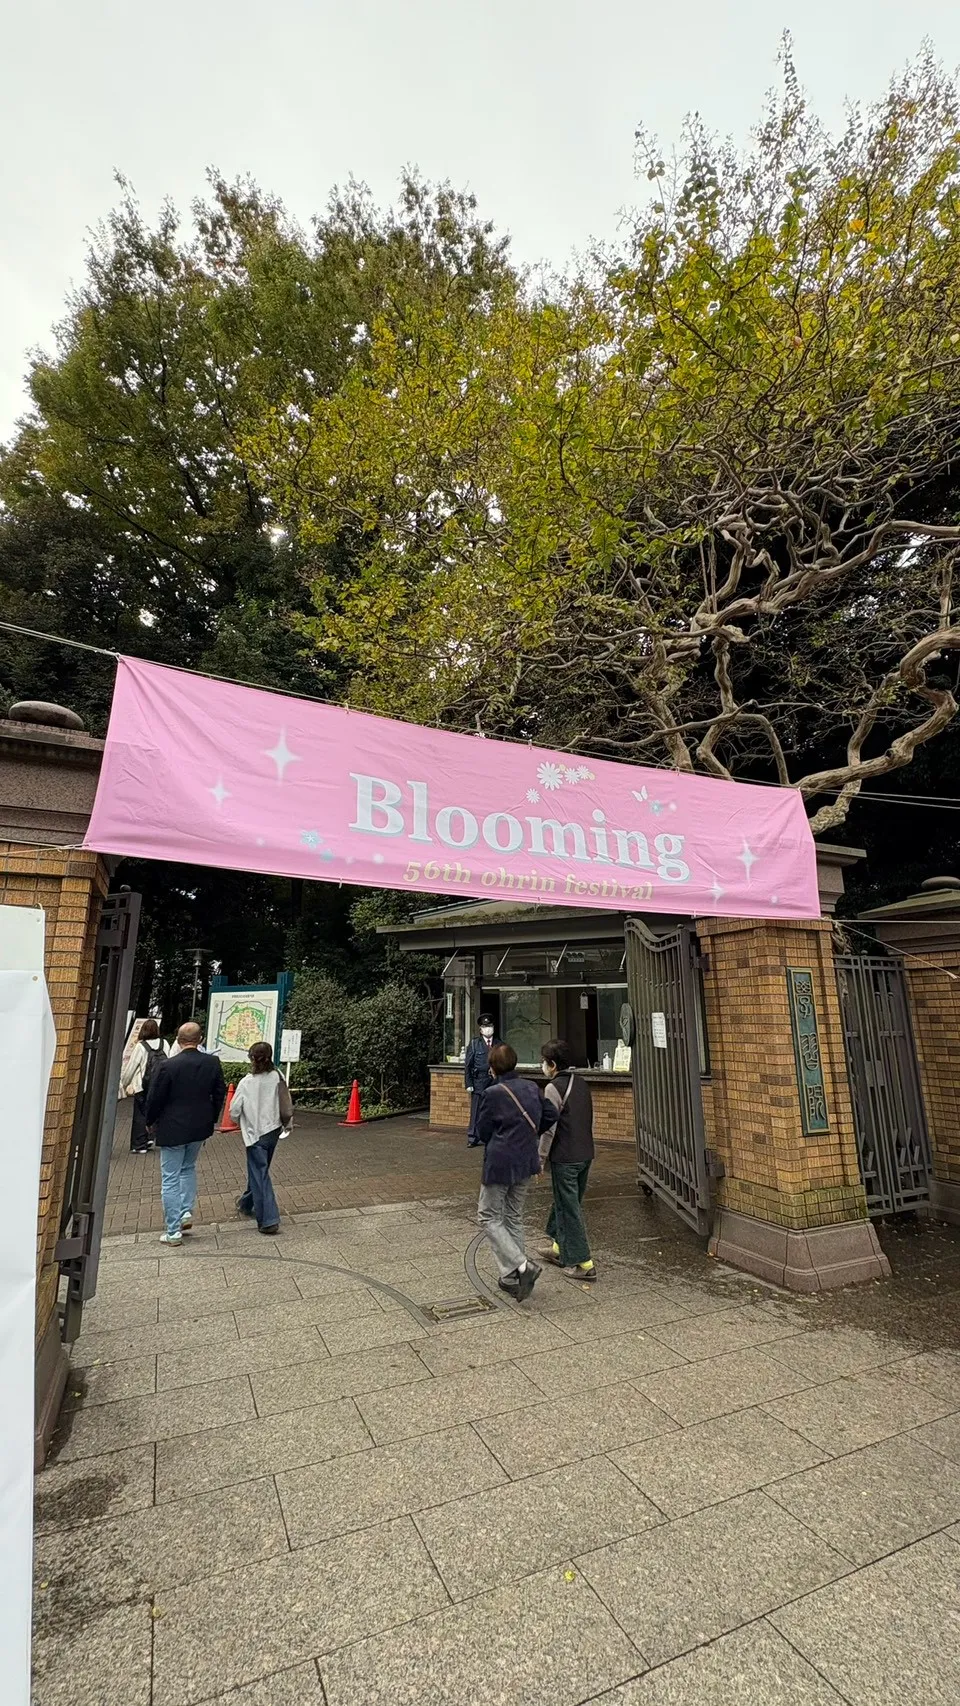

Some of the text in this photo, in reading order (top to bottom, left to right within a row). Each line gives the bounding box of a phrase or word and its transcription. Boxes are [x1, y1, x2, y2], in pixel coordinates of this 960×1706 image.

[348, 772, 691, 883] Blooming
[402, 860, 655, 901] 56th ohrin festival
